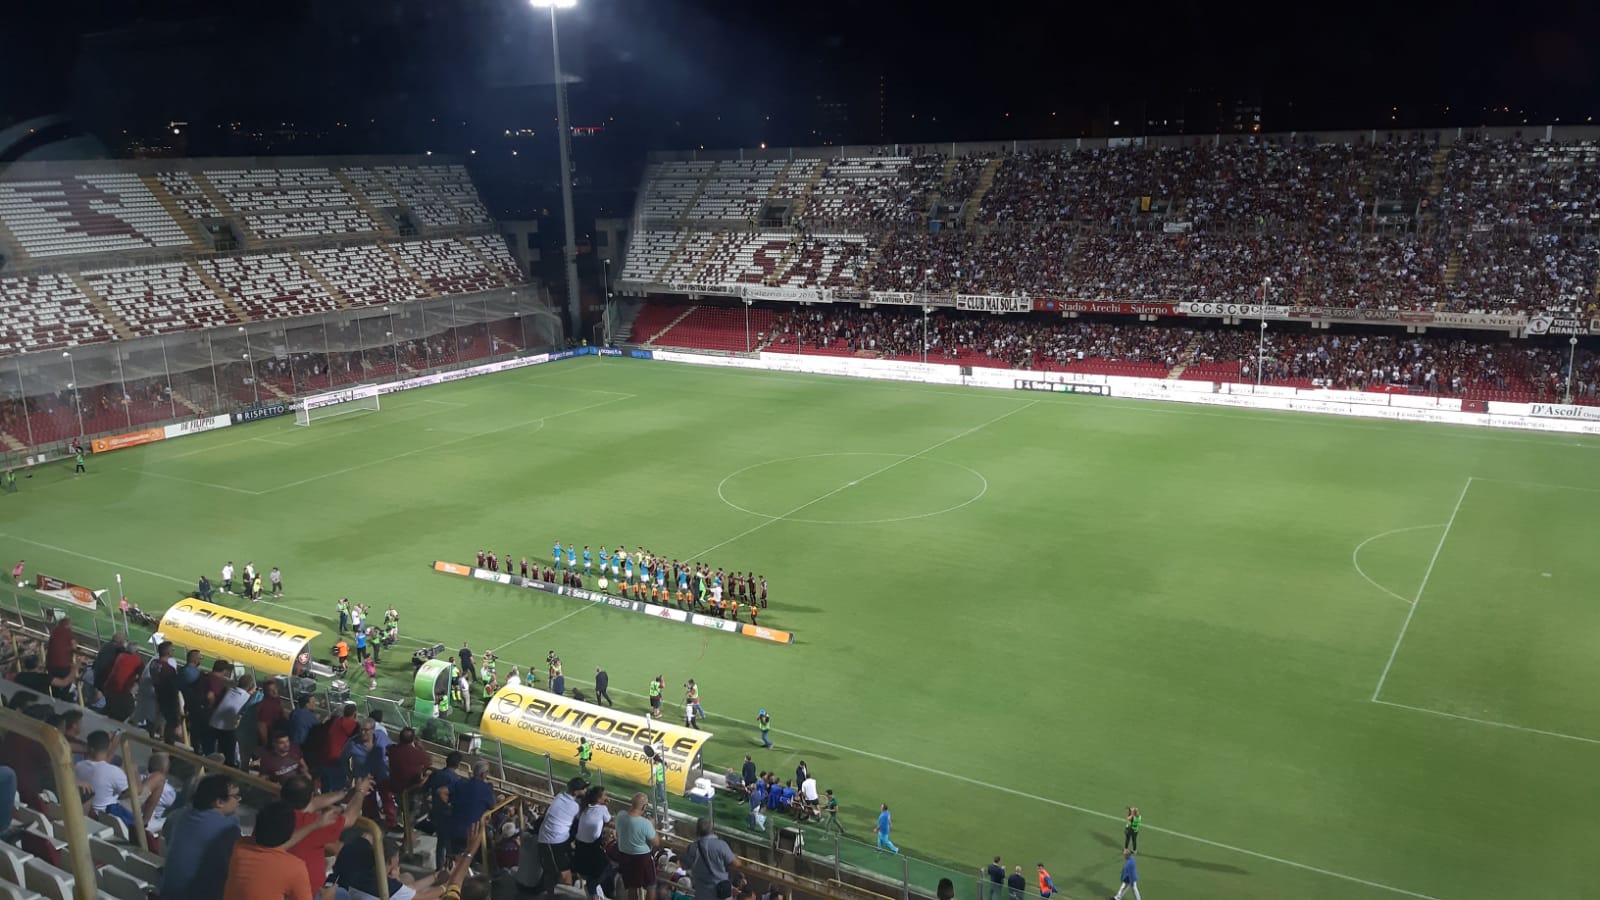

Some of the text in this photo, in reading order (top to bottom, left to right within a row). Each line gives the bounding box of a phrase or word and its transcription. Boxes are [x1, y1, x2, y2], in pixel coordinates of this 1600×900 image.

[966, 296, 985, 310] CLUB
[1000, 298, 1018, 311] SOLA
[1058, 301, 1087, 311] Stadio
[1090, 303, 1120, 313] Arechi
[1130, 304, 1168, 314] Salerno
[244, 405, 285, 419] RISPETTO
[1531, 404, 1583, 417] D'Ascoli
[490, 713, 511, 725] OPEL
[517, 720, 580, 744] CONCESSIONARIA
[596, 741, 632, 759] SALERNO
